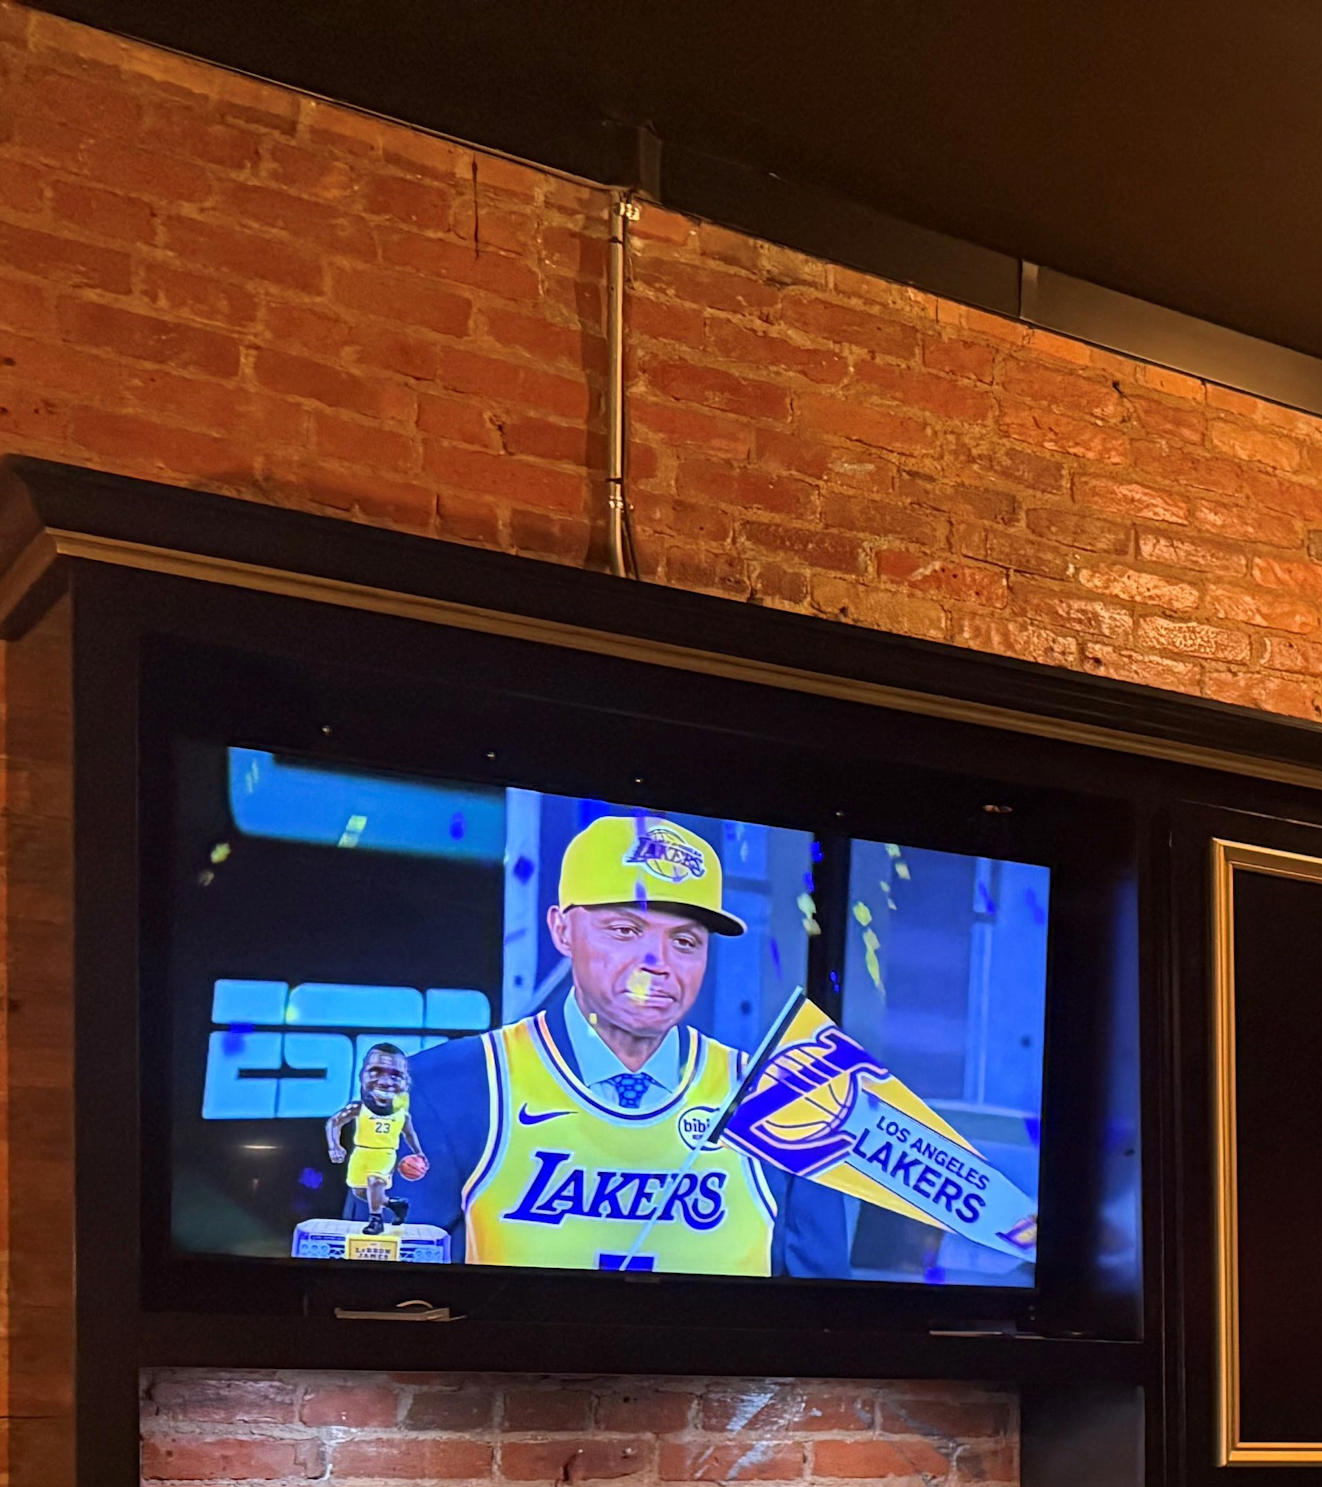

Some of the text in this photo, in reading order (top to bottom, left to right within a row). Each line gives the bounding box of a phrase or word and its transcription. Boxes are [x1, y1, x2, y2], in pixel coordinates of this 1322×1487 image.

[375, 1121, 391, 1134] 23
[875, 1115, 991, 1191] LOS ANGELES
[502, 1150, 727, 1231] LAKERS
[852, 1127, 987, 1224] LAKERS
